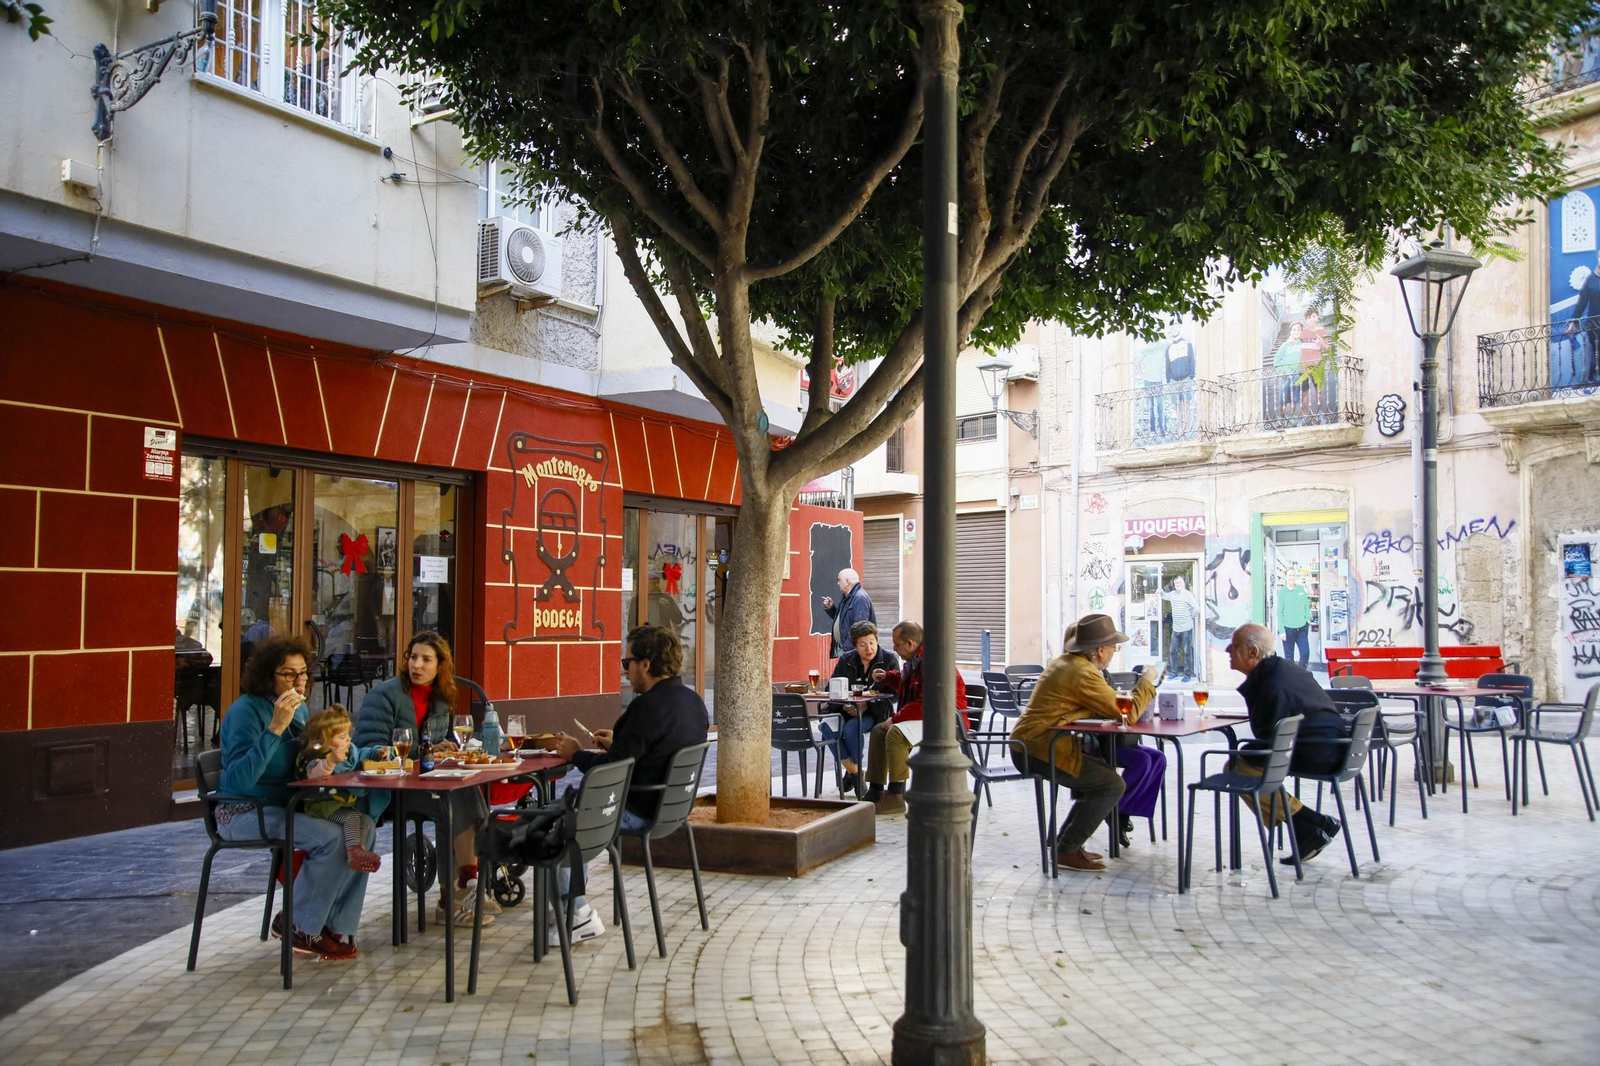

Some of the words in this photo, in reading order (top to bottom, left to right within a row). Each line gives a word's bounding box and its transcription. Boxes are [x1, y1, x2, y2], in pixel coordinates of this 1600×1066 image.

[151, 448, 169, 456] Alarma
[522, 456, 598, 493] Montenegro
[1124, 517, 1205, 535] LUQUERIA
[534, 608, 581, 629] BODEGA
[1357, 628, 1394, 646] 2021
